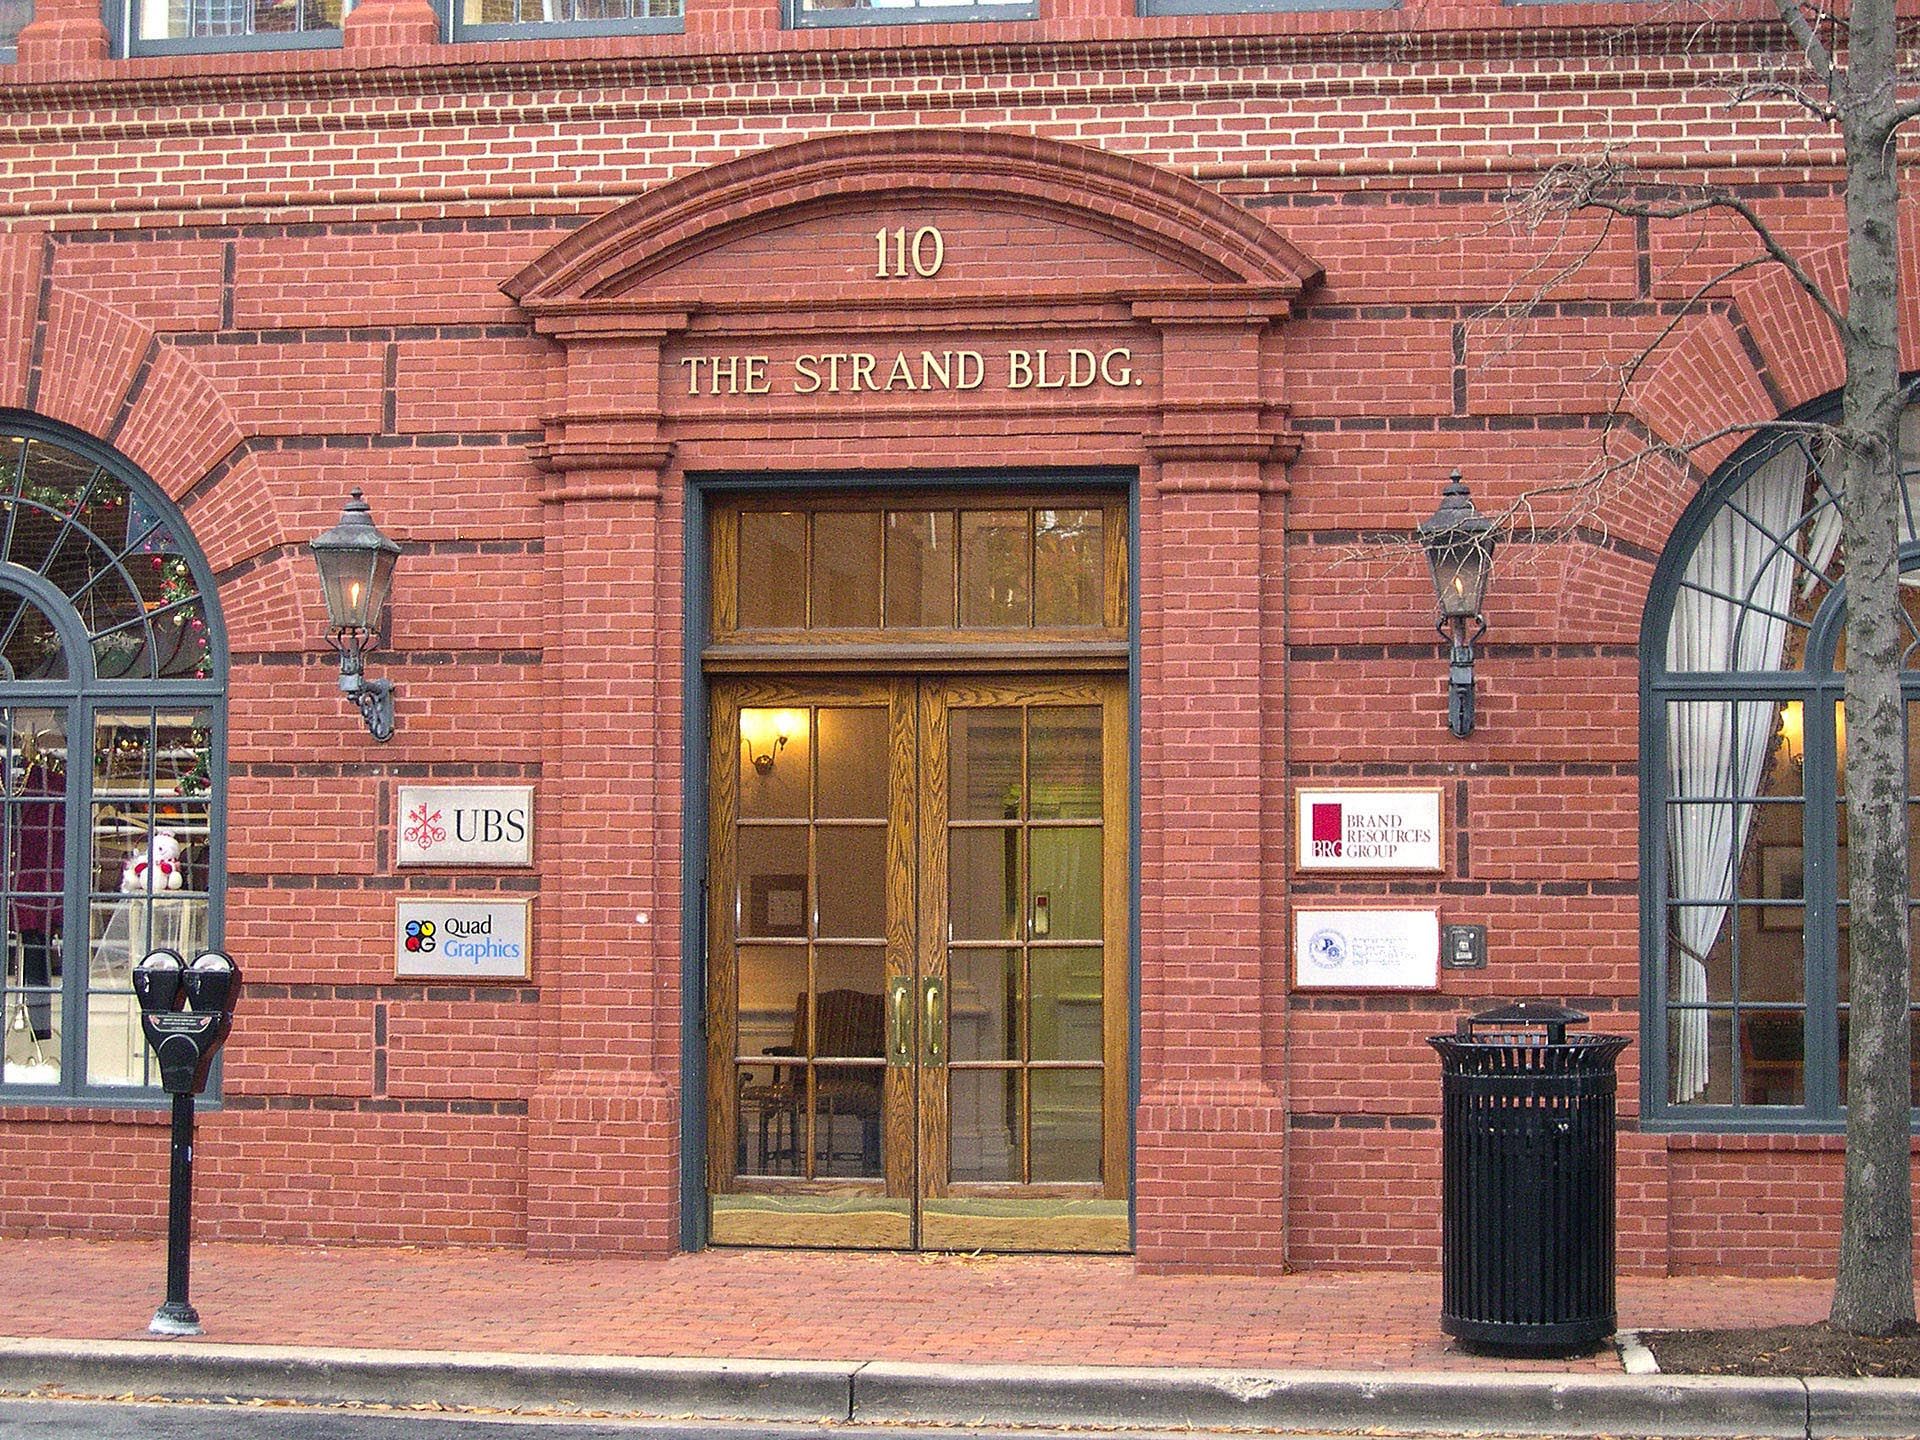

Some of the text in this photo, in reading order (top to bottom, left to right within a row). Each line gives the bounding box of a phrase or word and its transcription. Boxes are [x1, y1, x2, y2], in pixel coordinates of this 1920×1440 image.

[875, 226, 944, 278] 110
[681, 347, 1144, 395] THE STRAND BLDG.
[454, 808, 525, 843] UBS
[1346, 814, 1402, 828] BRAND
[1346, 829, 1432, 843] RESOURCES
[1346, 844, 1398, 858] GROUP
[444, 914, 492, 938] Quad
[444, 937, 520, 965] Graphics
